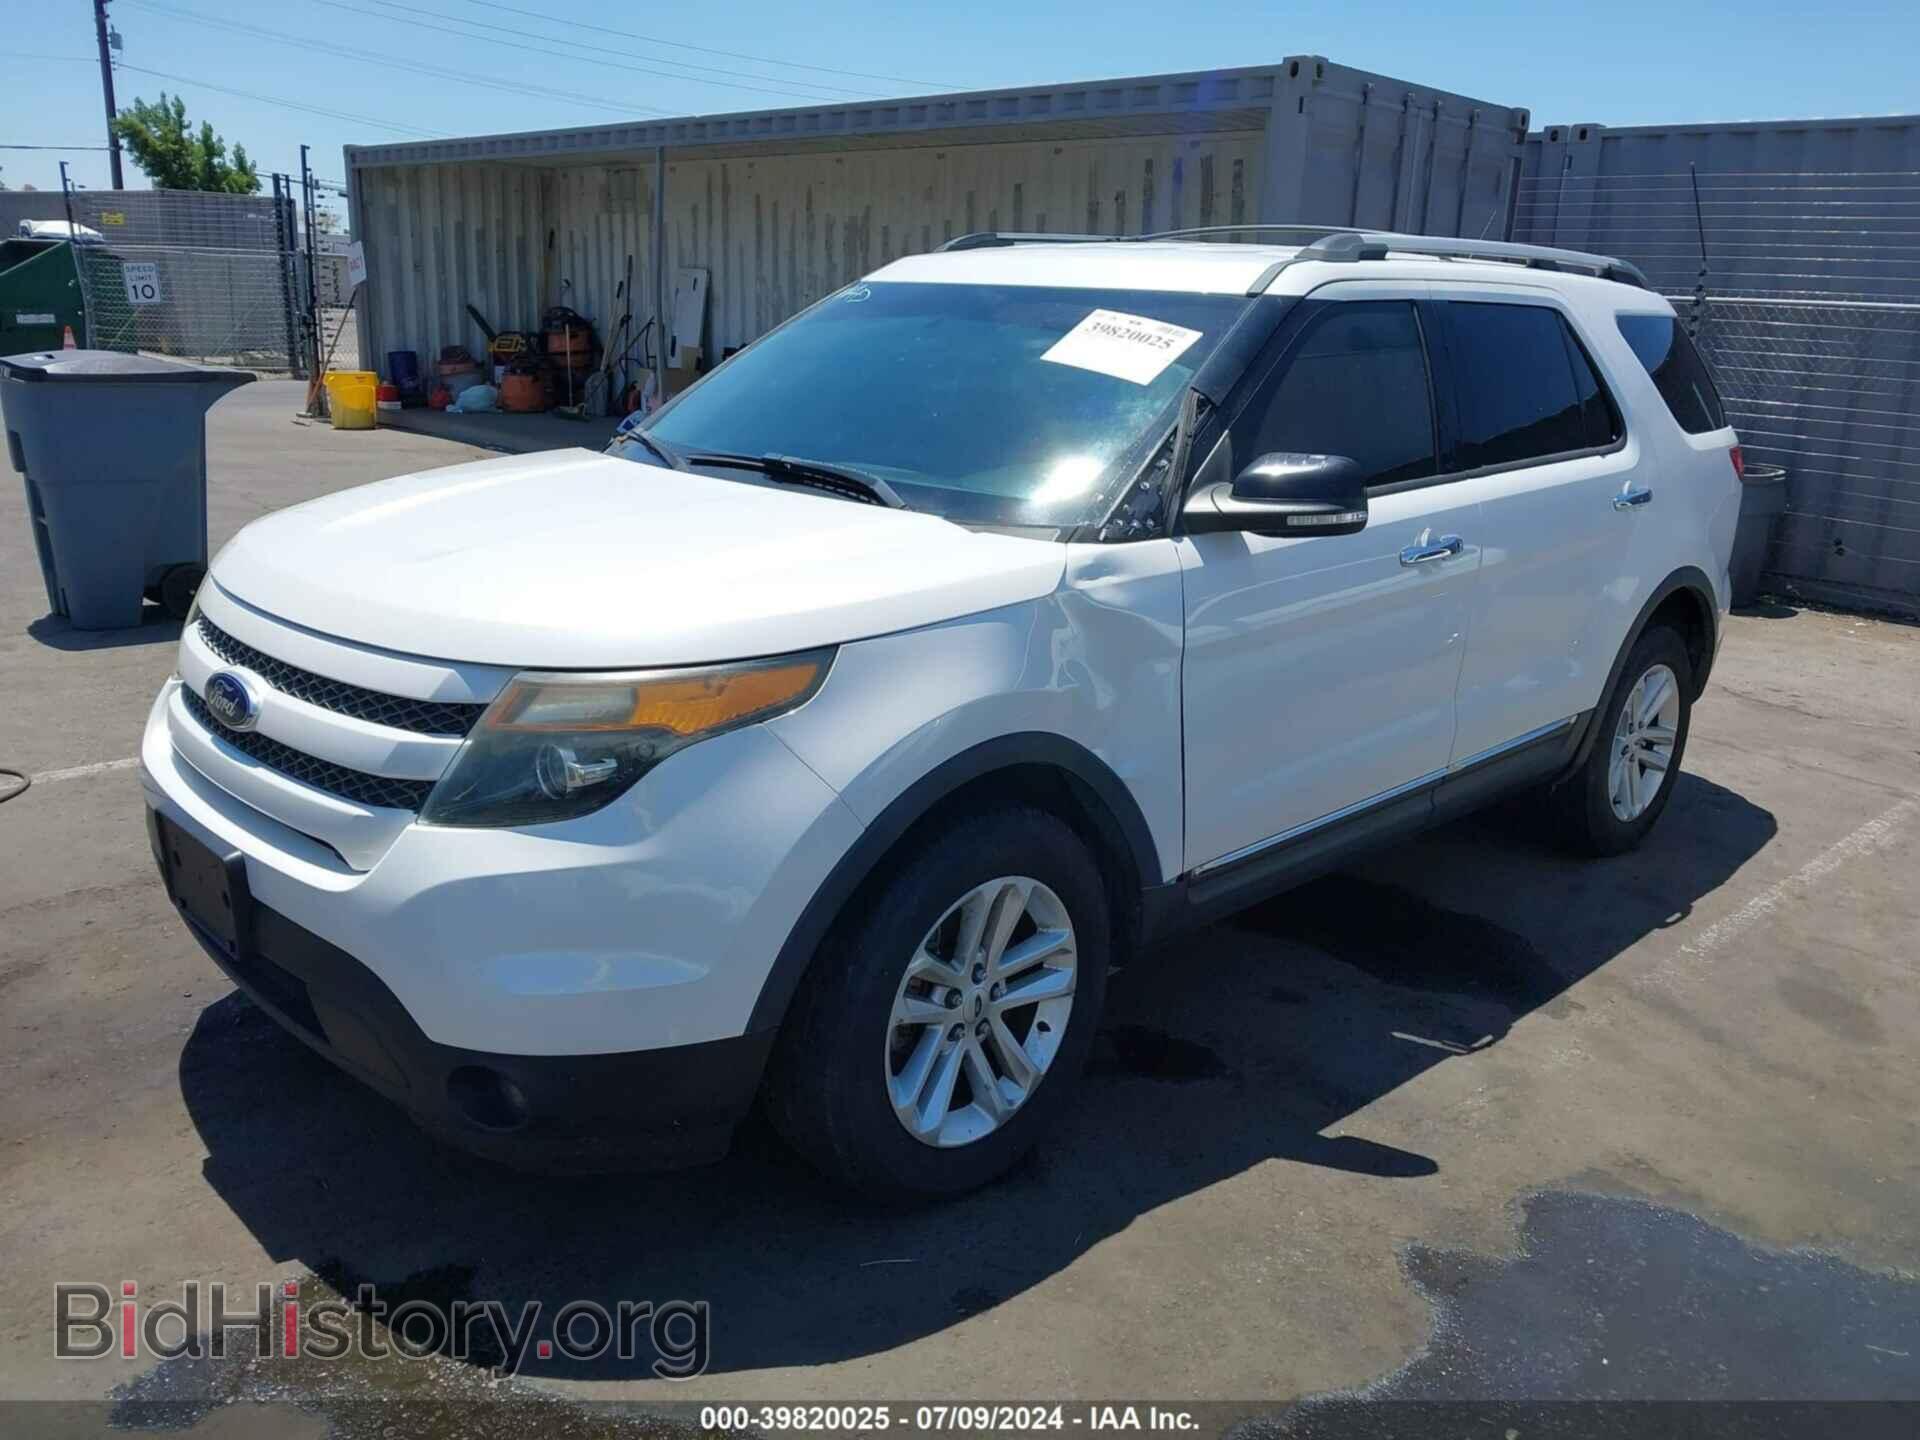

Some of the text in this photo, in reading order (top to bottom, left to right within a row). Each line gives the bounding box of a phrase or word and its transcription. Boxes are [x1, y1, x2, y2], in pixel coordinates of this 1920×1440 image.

[126, 265, 155, 273] SPEED
[132, 284, 155, 300] 10
[1085, 321, 1175, 349] 39820025
[208, 679, 240, 717] Ford
